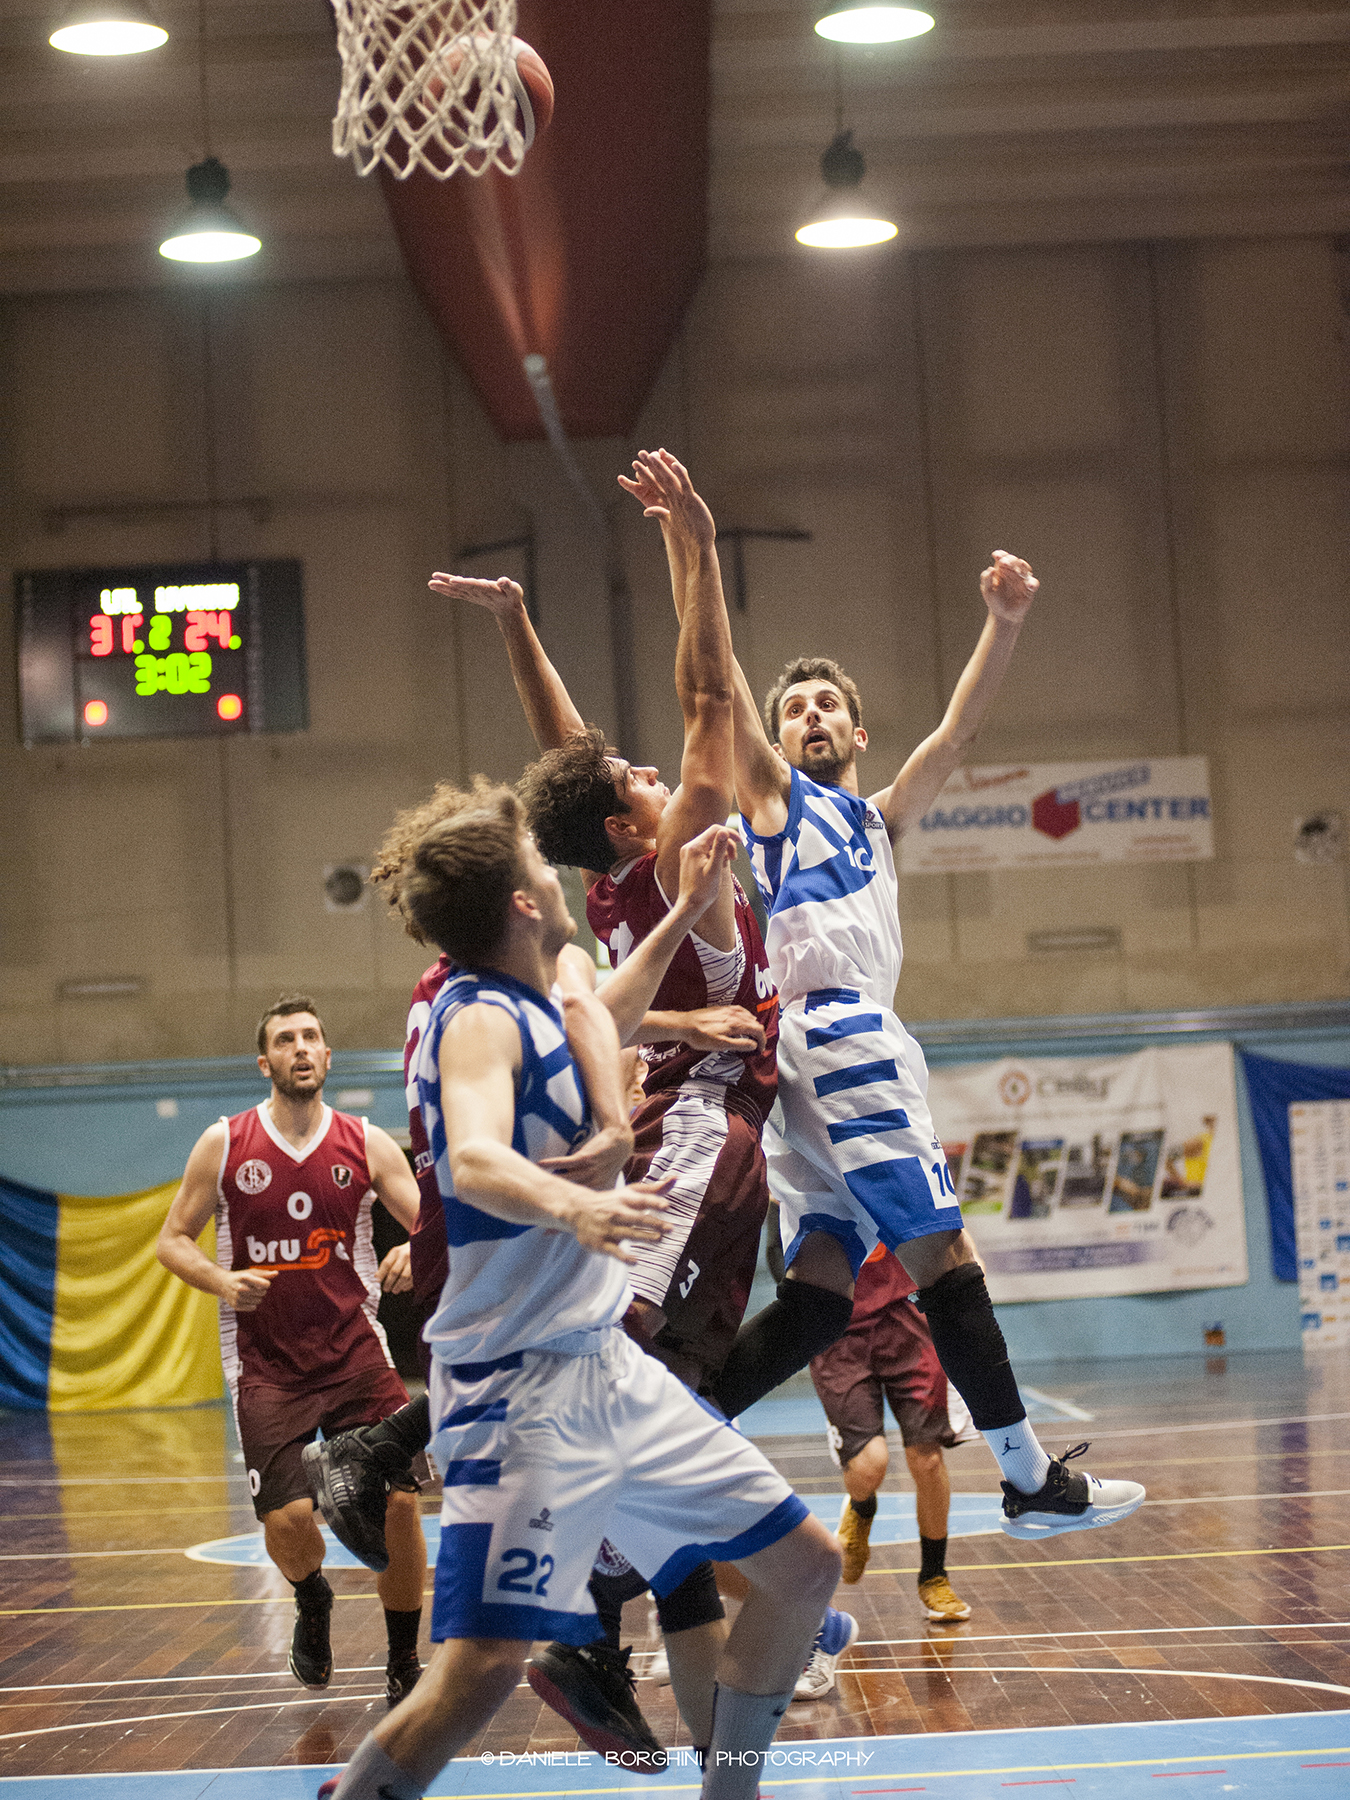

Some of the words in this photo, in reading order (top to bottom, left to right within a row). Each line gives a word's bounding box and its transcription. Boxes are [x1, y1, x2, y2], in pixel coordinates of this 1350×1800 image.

[135, 652, 212, 695] 3:02
[1085, 796, 1211, 823] CENTER
[287, 1191, 313, 1220] 0
[679, 1259, 700, 1299] 3
[497, 1547, 554, 1597] 22
